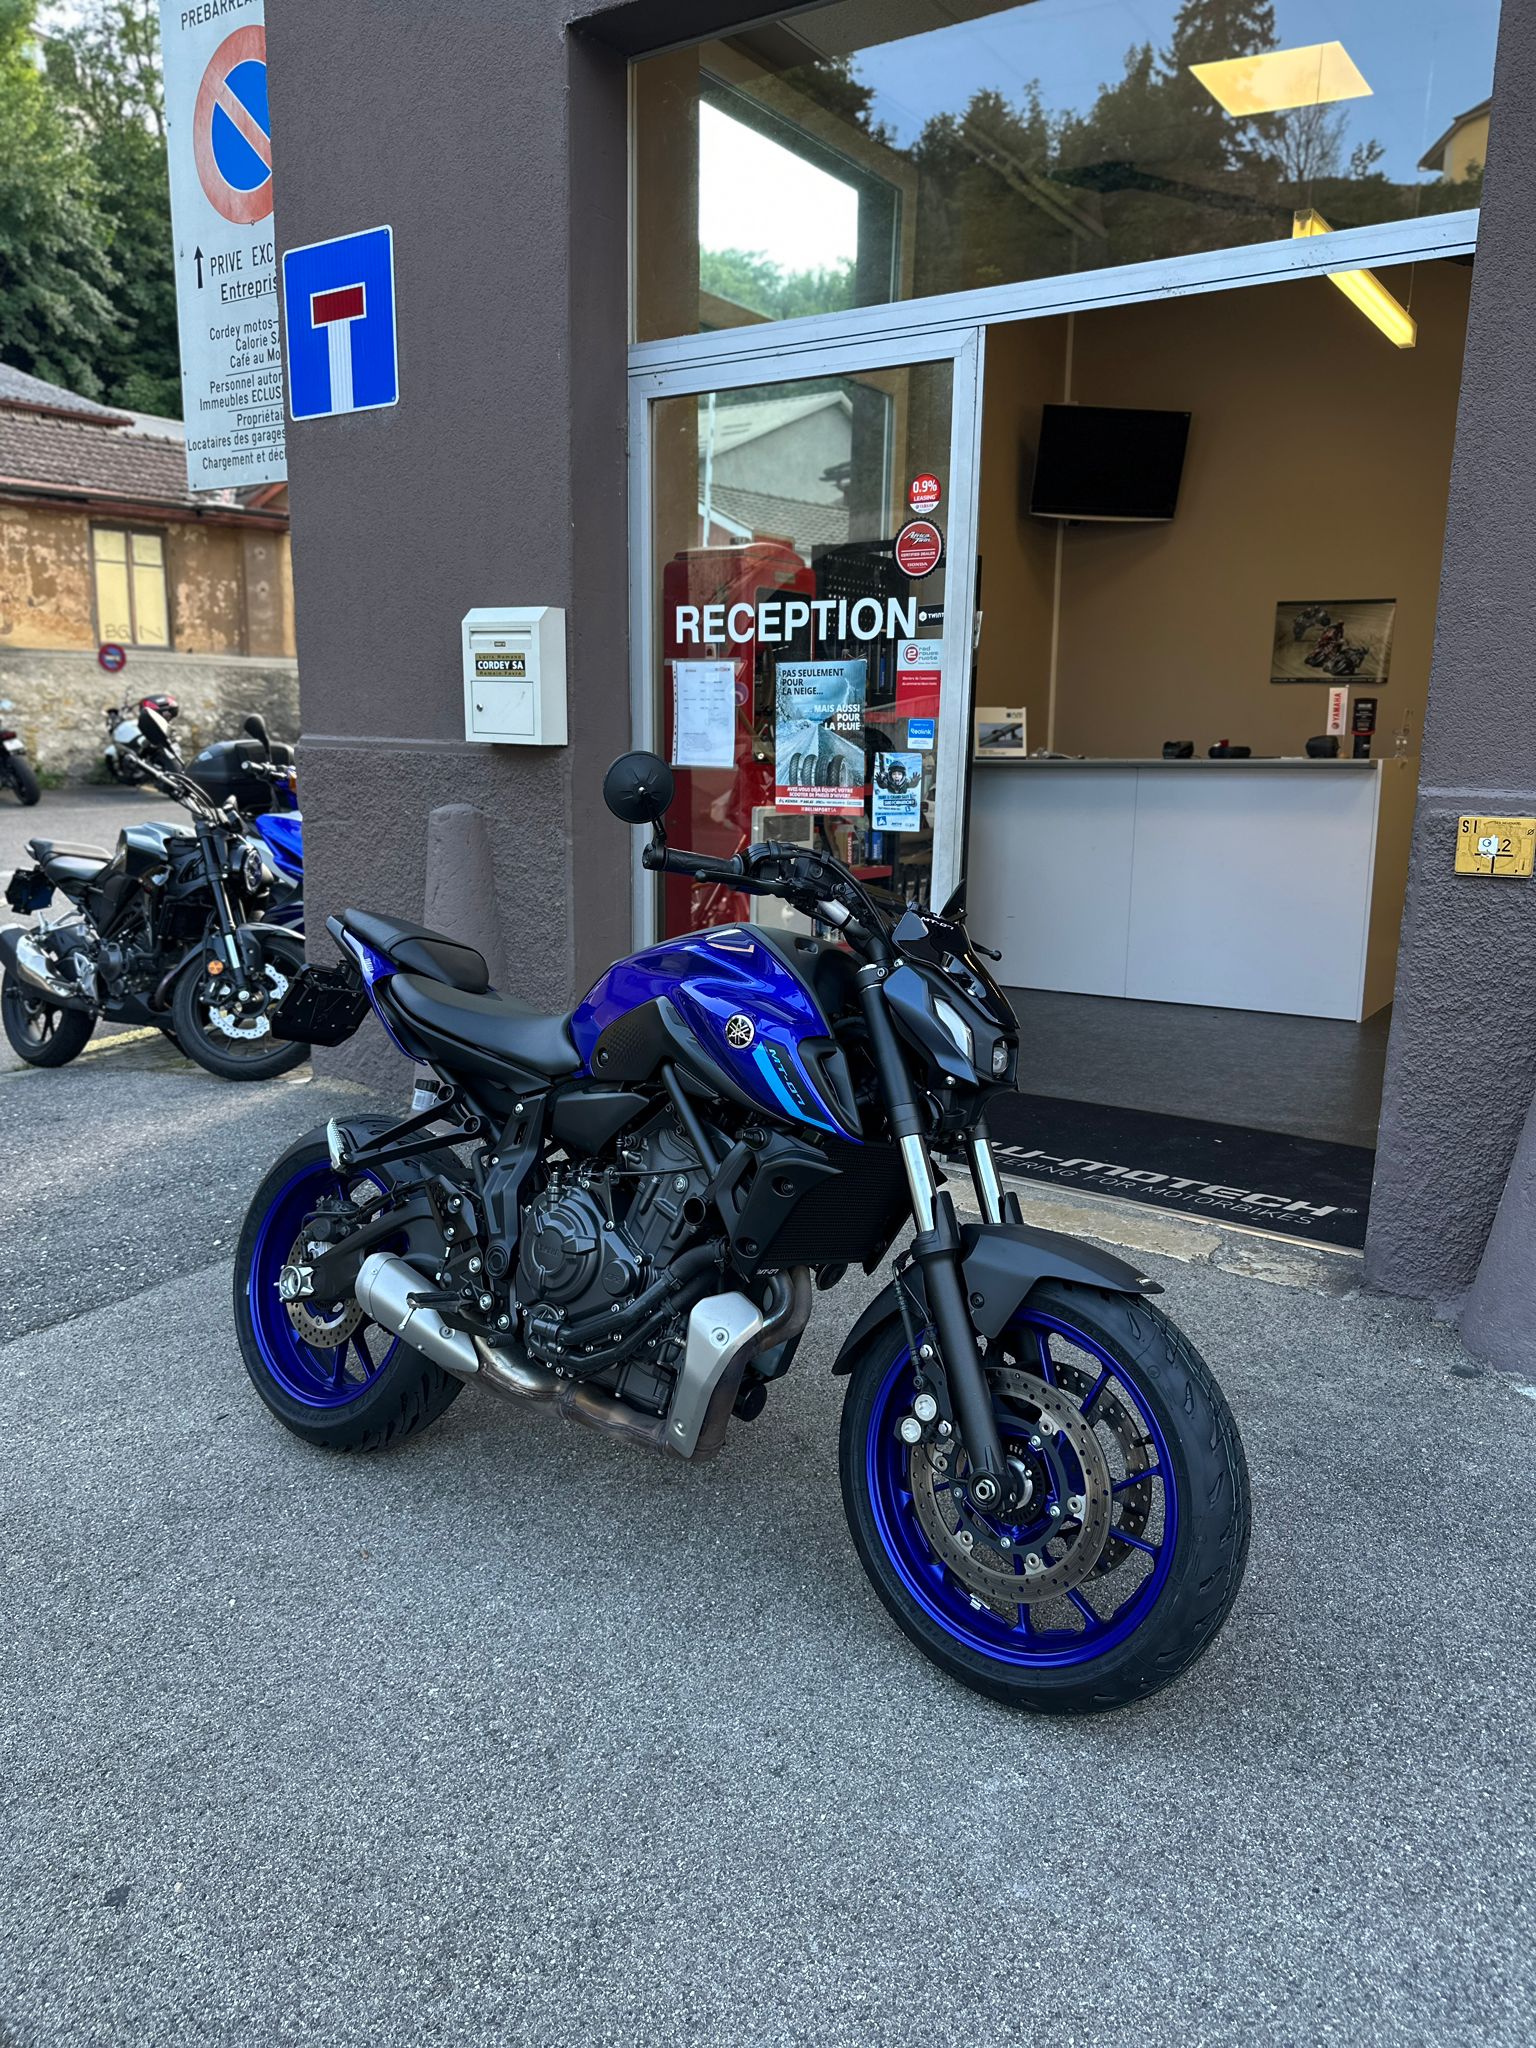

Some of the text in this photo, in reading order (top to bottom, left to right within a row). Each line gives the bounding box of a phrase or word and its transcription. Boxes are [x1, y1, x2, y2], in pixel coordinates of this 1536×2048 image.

[181, 0, 260, 31] PREBARRE
[210, 242, 274, 276] PRIVE EXC
[209, 324, 240, 341] Cordey
[235, 331, 280, 352] Calorie S
[230, 348, 281, 368] Café au Mo
[210, 374, 255, 394] Personnel
[200, 386, 281, 411] Immeubles ECLUS
[187, 429, 286, 452] Locataires des garages
[202, 453, 254, 470] Chargement
[256, 453, 265, 463] et
[912, 479, 938, 494] 0.9%
[903, 531, 931, 540] Africa
[911, 537, 931, 546] Twin
[676, 597, 917, 643] RECEPTION
[907, 648, 917, 659] 2
[477, 661, 524, 670] CORDEY SA
[782, 668, 844, 678] PAS SEULEMENT
[782, 678, 804, 687] POUR
[782, 687, 792, 696] LA
[836, 704, 860, 713] AUSSI
[1332, 692, 1342, 722] YAMAHA
[836, 713, 860, 722] POUR
[824, 722, 860, 731] LA PLUIE
[768, 1048, 805, 1106] MT-07
[1083, 1174, 1137, 1190] FOR
[1140, 1186, 1315, 1226] MOTORBIKES
